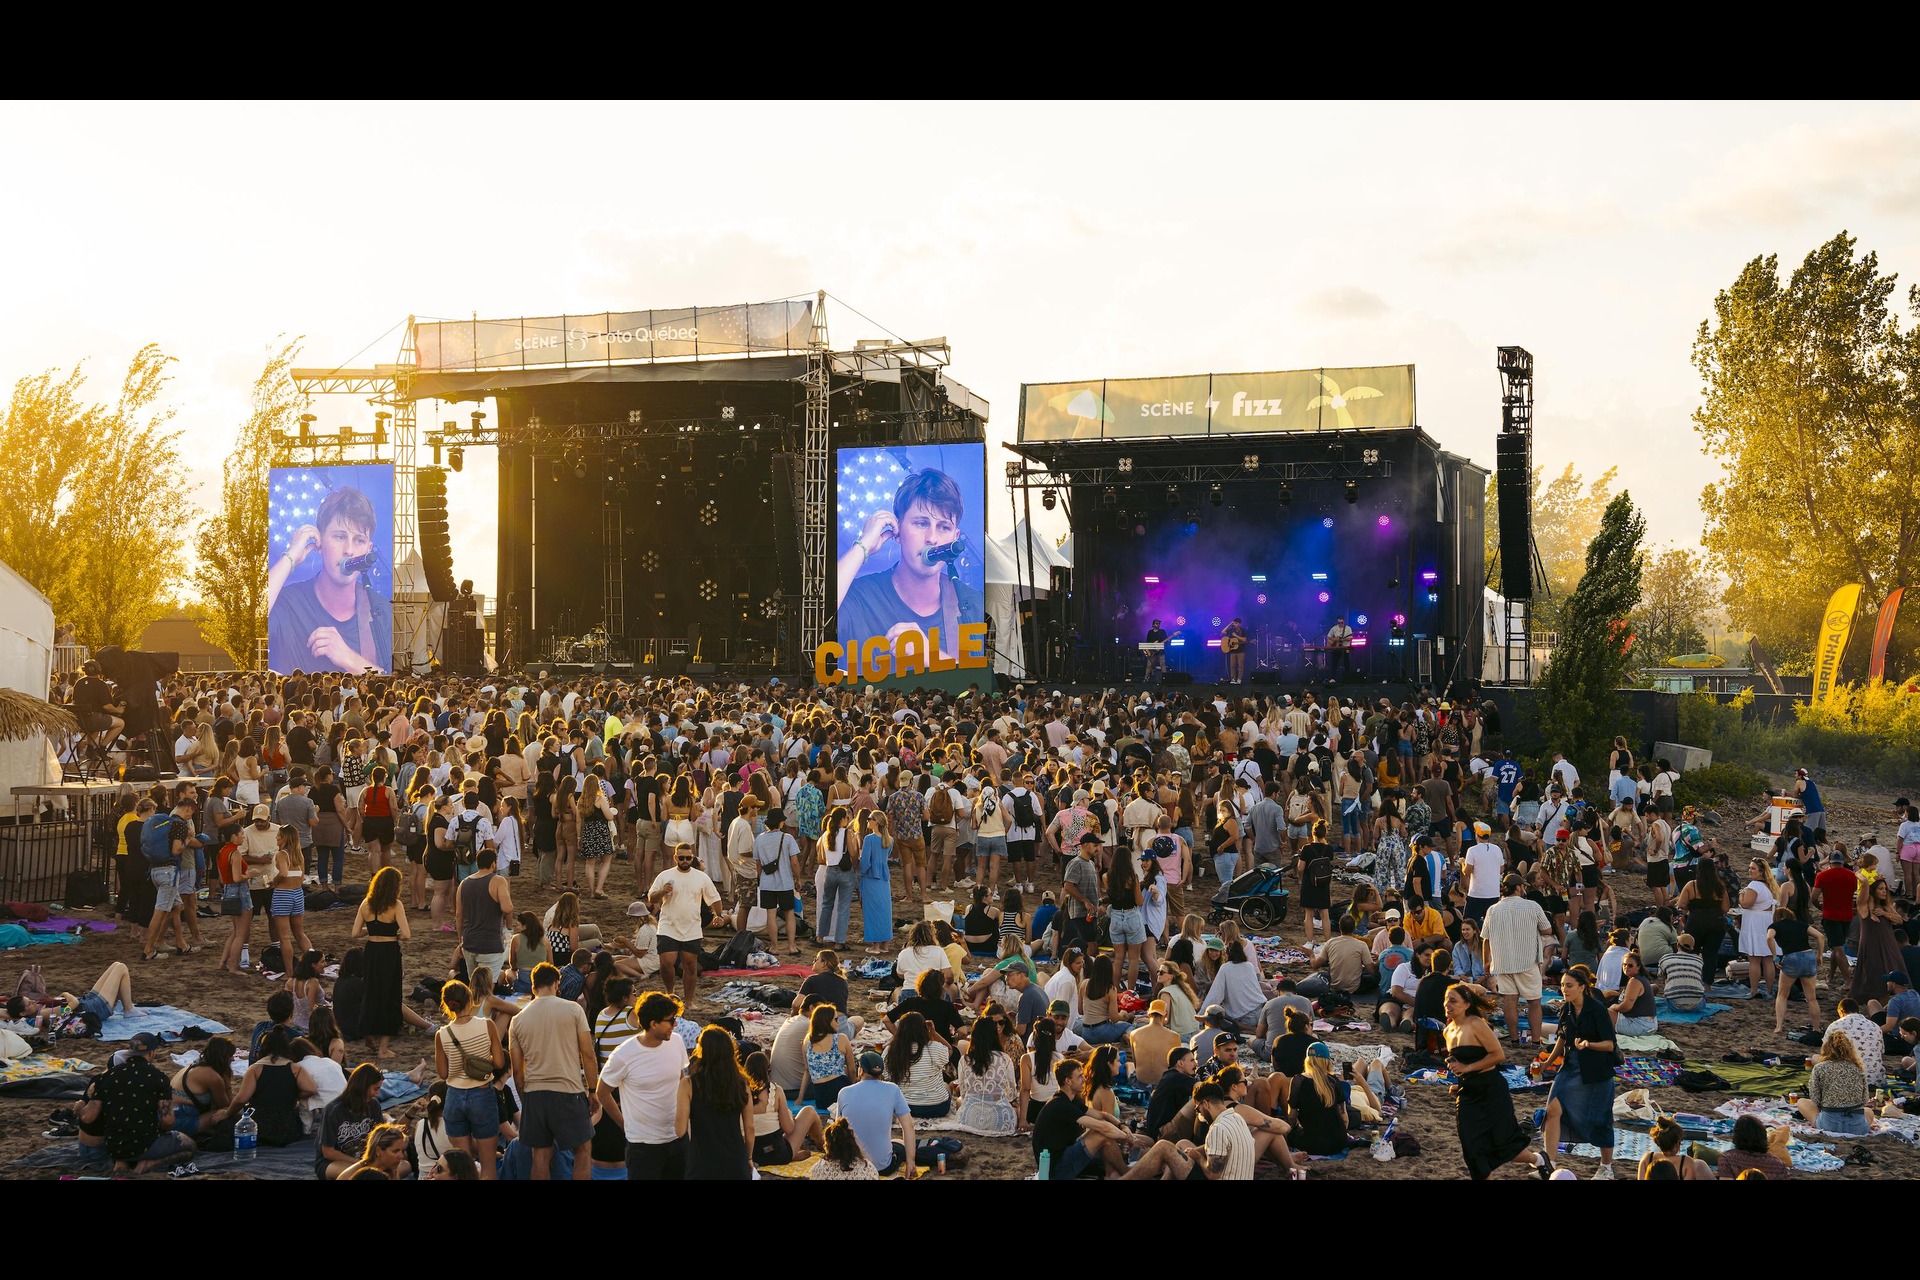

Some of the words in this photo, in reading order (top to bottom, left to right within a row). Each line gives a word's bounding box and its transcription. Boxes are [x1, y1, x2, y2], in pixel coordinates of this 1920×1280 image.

[514, 334, 558, 350] SCÈNE
[598, 330, 633, 345] Loto
[635, 326, 698, 343] Québec
[1141, 400, 1194, 417] SCÈNE
[1232, 391, 1283, 417] fizz
[815, 622, 988, 688] CIGALE
[1817, 633, 1842, 702] ABRINHA
[1500, 771, 1517, 784] 27
